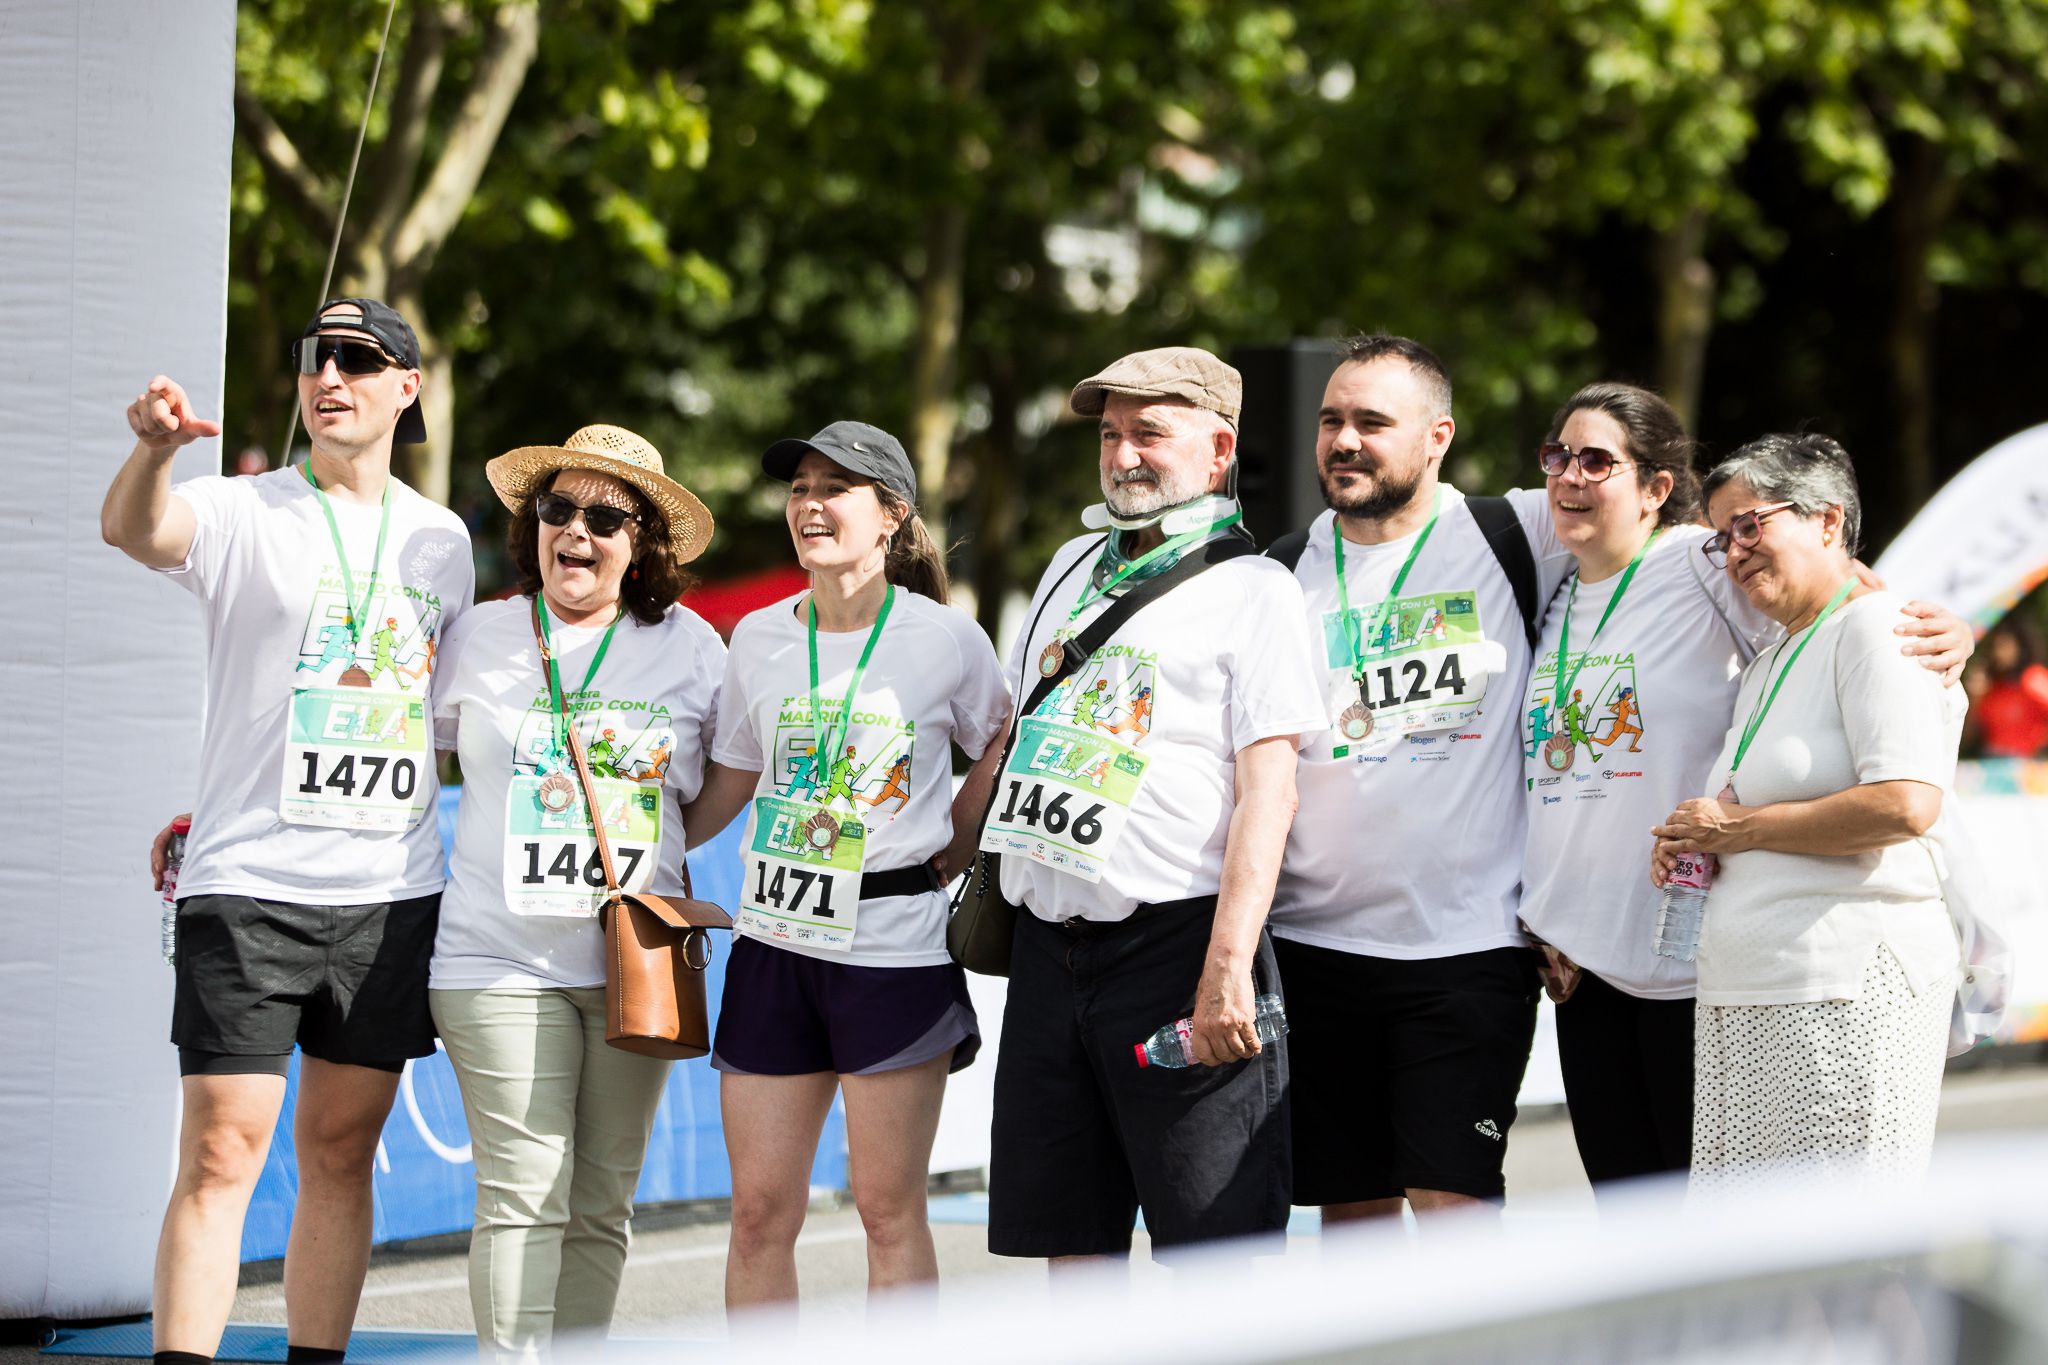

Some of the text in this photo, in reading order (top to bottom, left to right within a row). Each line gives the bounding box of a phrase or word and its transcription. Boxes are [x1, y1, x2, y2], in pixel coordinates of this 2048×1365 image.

[391, 585, 423, 600] CON
[426, 592, 442, 606] LA
[1401, 598, 1436, 610] CON LA
[1360, 606, 1447, 657] ELA
[1106, 645, 1137, 658] CON
[1136, 649, 1159, 663] LA
[1583, 655, 1613, 668] CON
[1614, 652, 1635, 665] LA
[1359, 653, 1467, 711] 1124
[564, 689, 600, 700] arrera
[782, 697, 795, 707] 3ª
[607, 699, 648, 711] CON
[649, 703, 670, 715] LA
[321, 702, 408, 744] ELA
[851, 711, 891, 727] CON
[895, 719, 915, 733] LA
[1080, 735, 1098, 746] CON
[1410, 736, 1437, 745] Biogen
[1028, 736, 1111, 788] ELA
[299, 751, 416, 800] 1470
[998, 780, 1107, 845] 1466
[1008, 840, 1028, 850] Biogen
[522, 843, 645, 888] 1467
[1053, 856, 1064, 864] LIFE
[754, 860, 836, 919] 1471
[1474, 1122, 1502, 1142] CRIVIT
